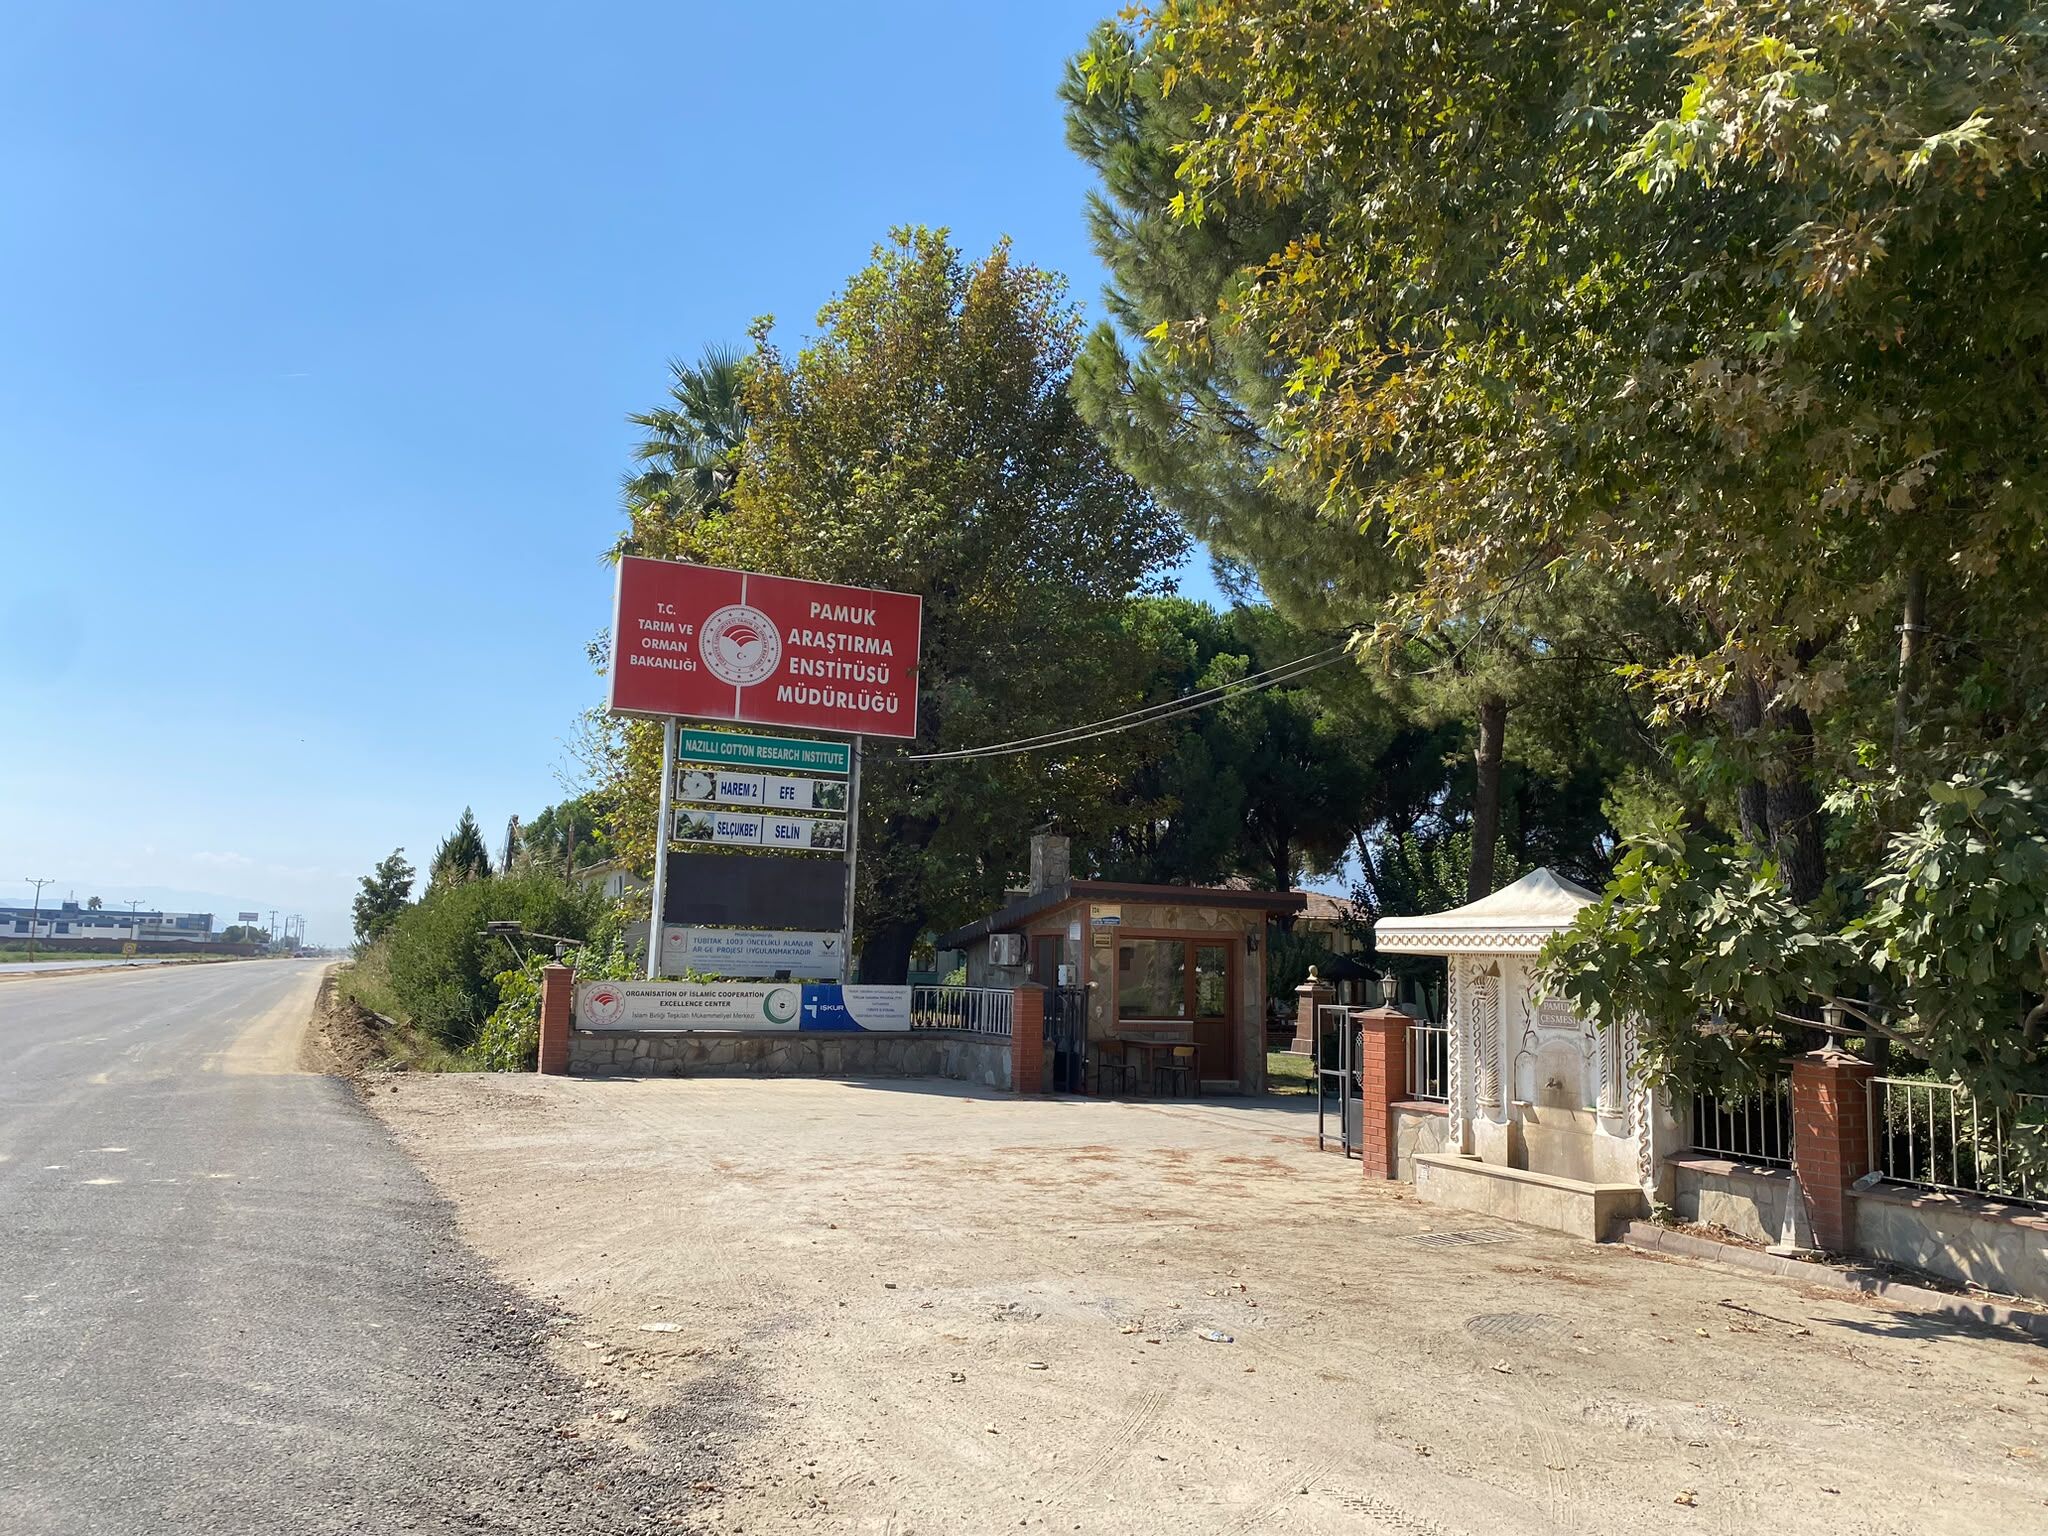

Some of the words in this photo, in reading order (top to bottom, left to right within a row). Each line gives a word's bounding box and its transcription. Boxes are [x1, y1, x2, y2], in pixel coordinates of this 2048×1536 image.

[657, 602, 676, 615] T.C.
[809, 601, 877, 626] PAMUK
[638, 618, 675, 633] TARIM
[678, 623, 693, 635] VE
[641, 637, 688, 653] ORMAN
[787, 627, 894, 657] ARAŞTIRMA
[629, 654, 697, 672] BAKANLIĞI
[788, 656, 890, 685] ENSTİTÜSÜ
[775, 681, 899, 714] MÜDÜRLÜĞÜ
[685, 739, 718, 754] NAZILLI
[720, 742, 754, 757] COTTON
[756, 745, 800, 761] RESEARCH
[801, 749, 844, 765] INSTITUTE
[720, 781, 750, 797] HAREM
[751, 783, 758, 798] 2
[779, 786, 795, 801] EFE
[716, 821, 758, 840] SELÇUKBEY
[775, 823, 800, 840] SELİN
